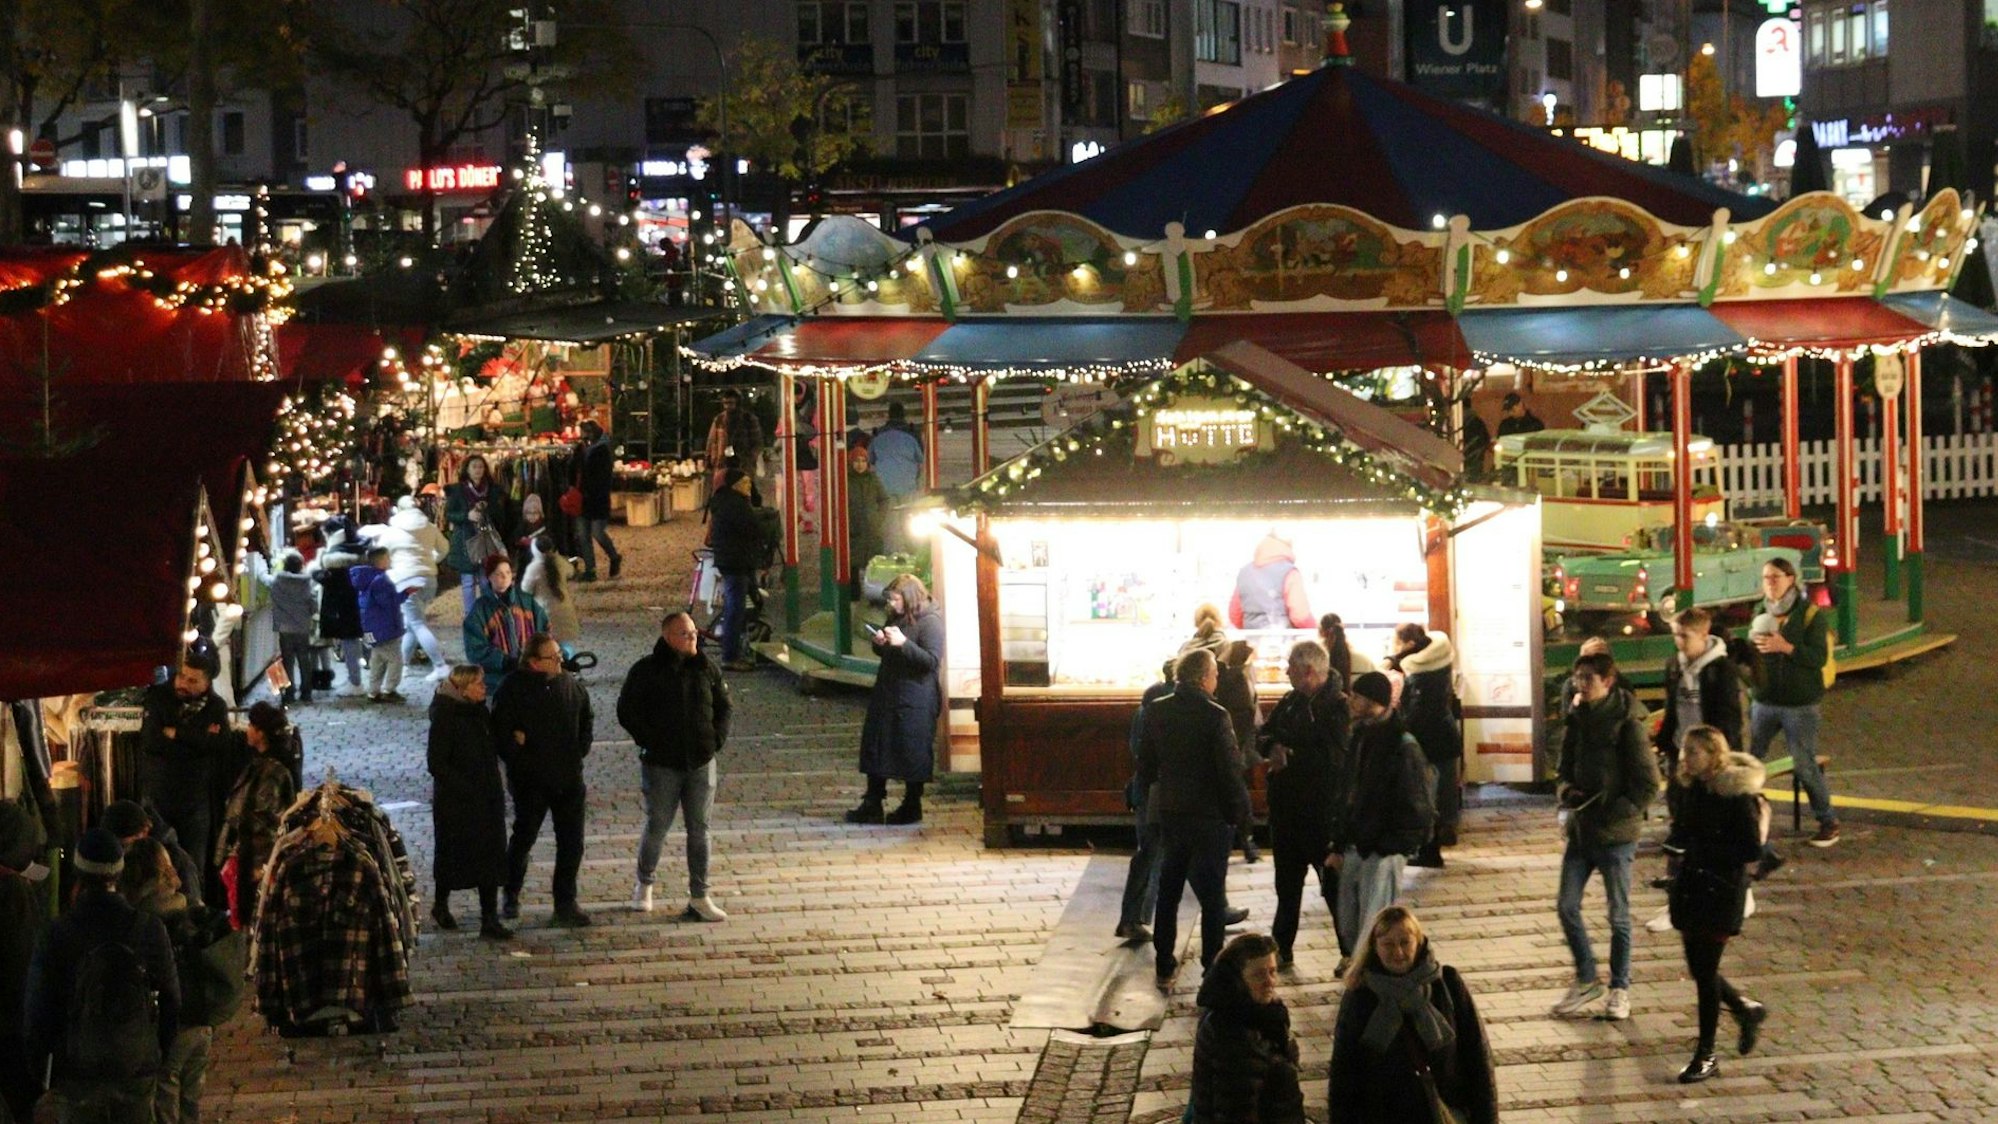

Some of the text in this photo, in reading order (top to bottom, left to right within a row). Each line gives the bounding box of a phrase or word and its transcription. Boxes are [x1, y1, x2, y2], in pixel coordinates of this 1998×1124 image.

[1438, 4, 1474, 56] U
[1415, 61, 1499, 75] Wiener Platz
